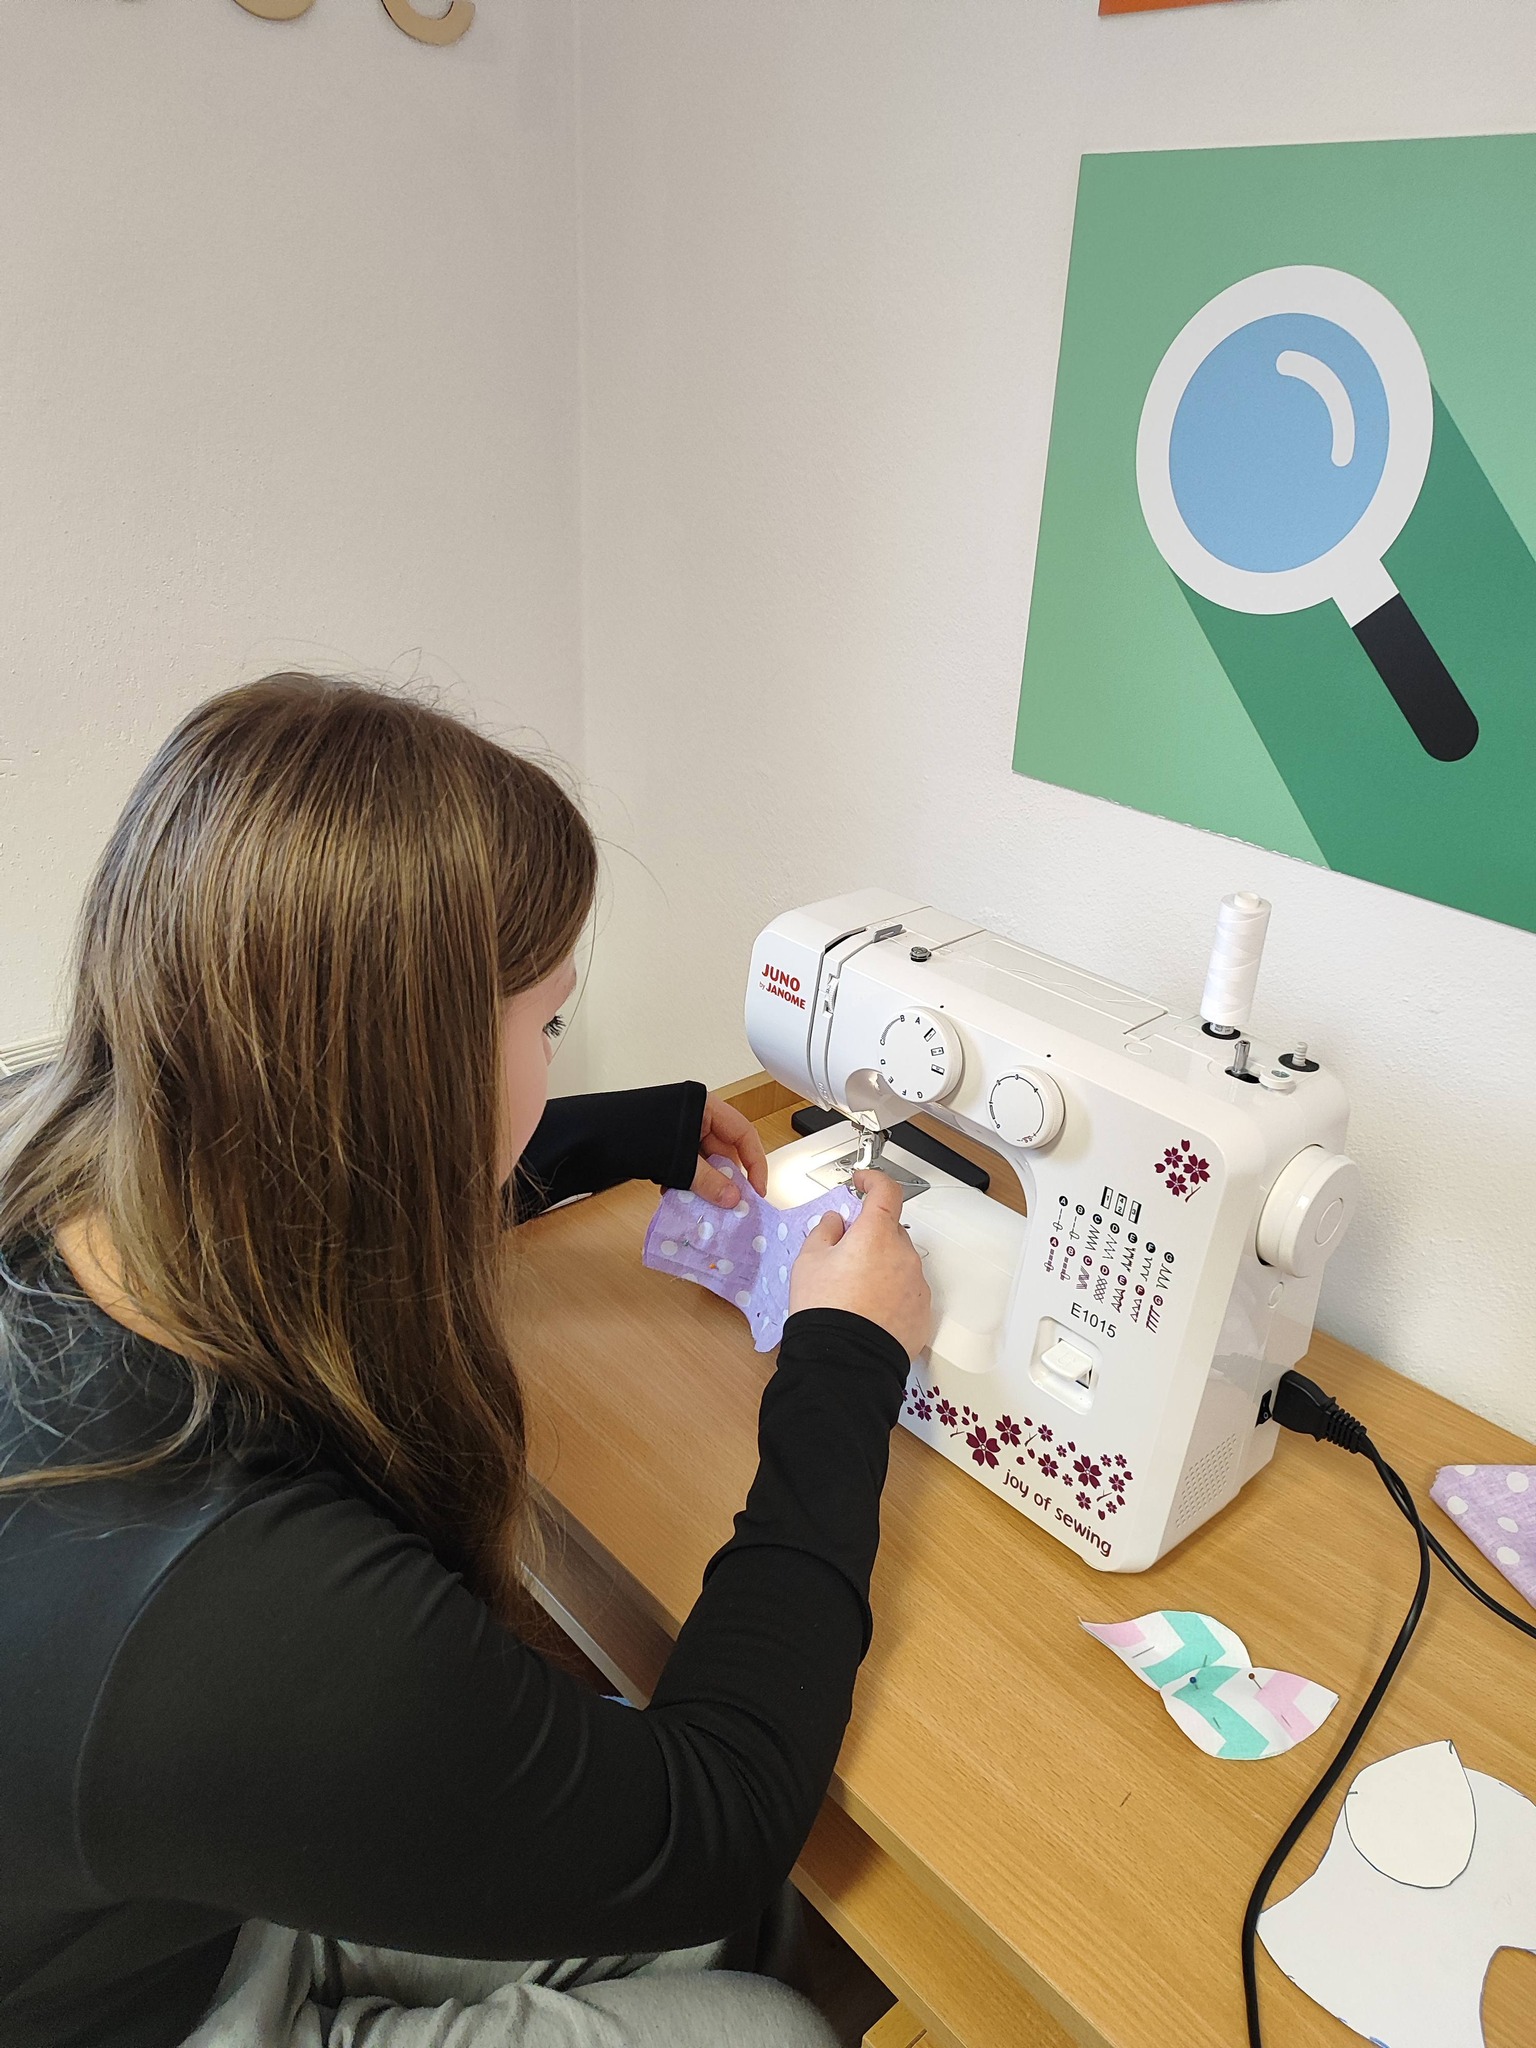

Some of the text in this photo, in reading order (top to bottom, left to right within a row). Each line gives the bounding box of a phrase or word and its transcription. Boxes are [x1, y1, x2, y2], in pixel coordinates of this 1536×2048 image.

[762, 964, 800, 992] JUNO
[759, 981, 765, 990] by
[766, 983, 806, 1010] JANOME
[1070, 1302, 1117, 1338] E1015
[1002, 1469, 1112, 1557] joy of sewing
